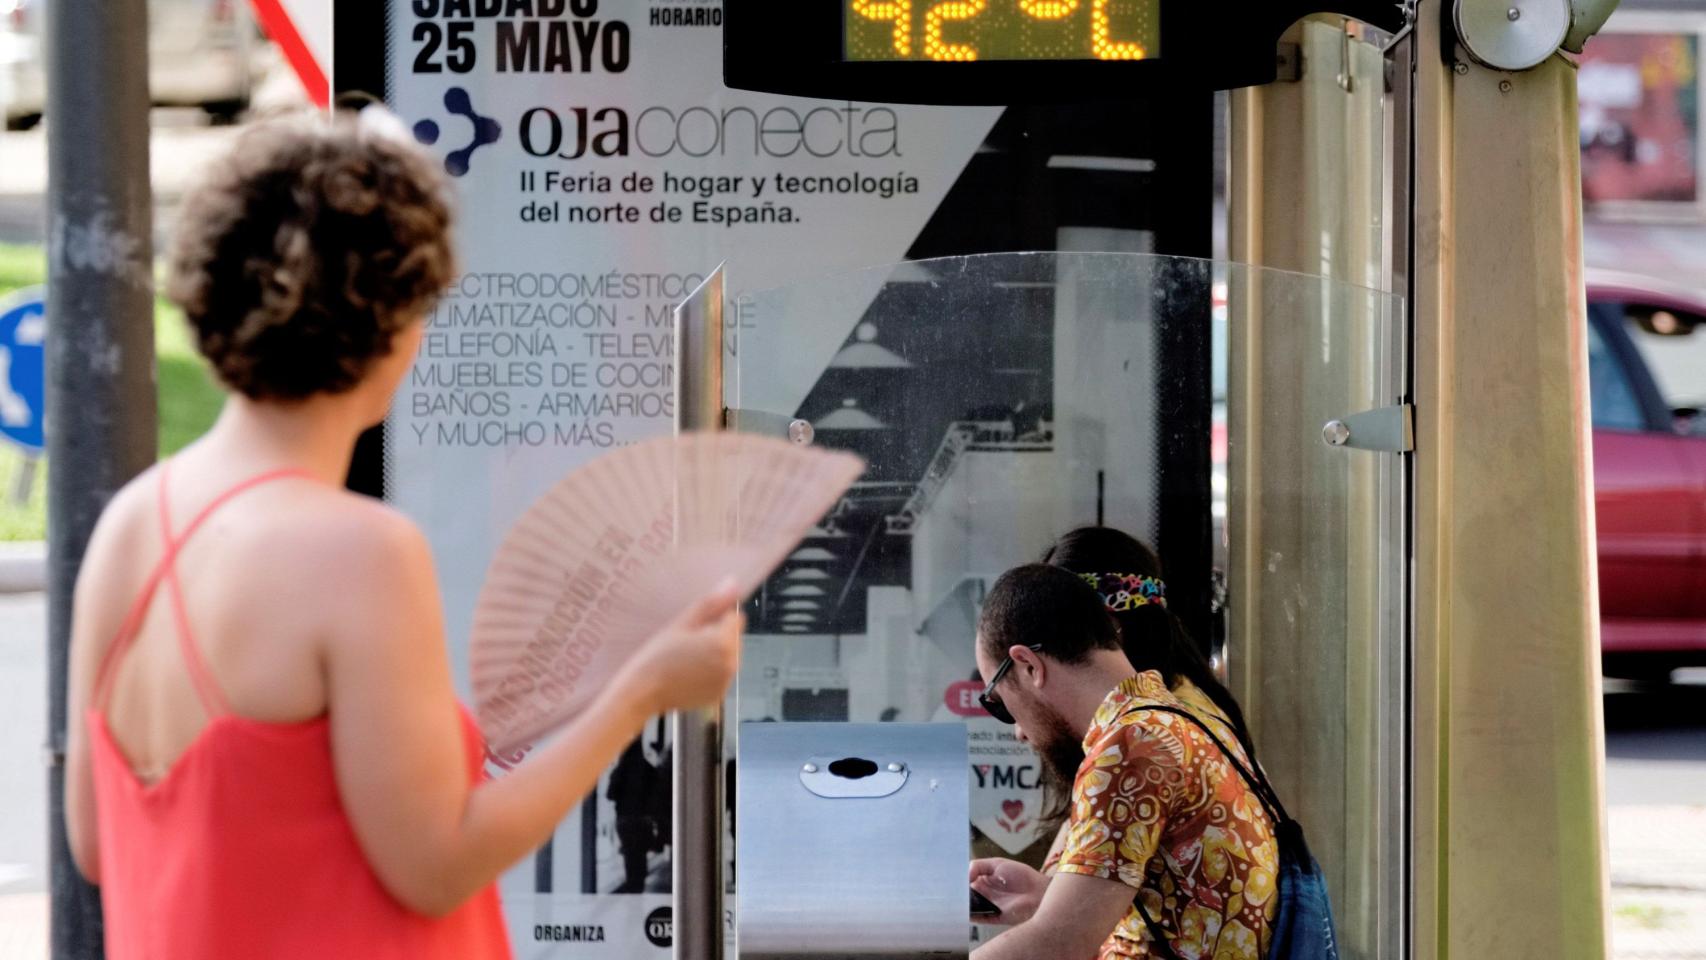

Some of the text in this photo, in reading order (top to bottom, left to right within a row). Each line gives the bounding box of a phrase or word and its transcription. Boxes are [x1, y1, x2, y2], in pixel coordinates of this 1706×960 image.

[649, 7, 722, 26] HORARIO
[412, 20, 630, 74] 25 MAYO
[518, 101, 903, 160] ojaconecta
[520, 172, 920, 198] II Feria de hogar y tecnología
[520, 203, 802, 229] del norte de España.
[411, 362, 543, 388] MUEBLES
[551, 363, 588, 387] DE
[411, 387, 511, 417] BAÑOS
[536, 392, 675, 417] ARMARIOS
[413, 423, 431, 446] Y
[437, 422, 546, 447] MUCHO
[534, 925, 605, 942] ORGANIZA
